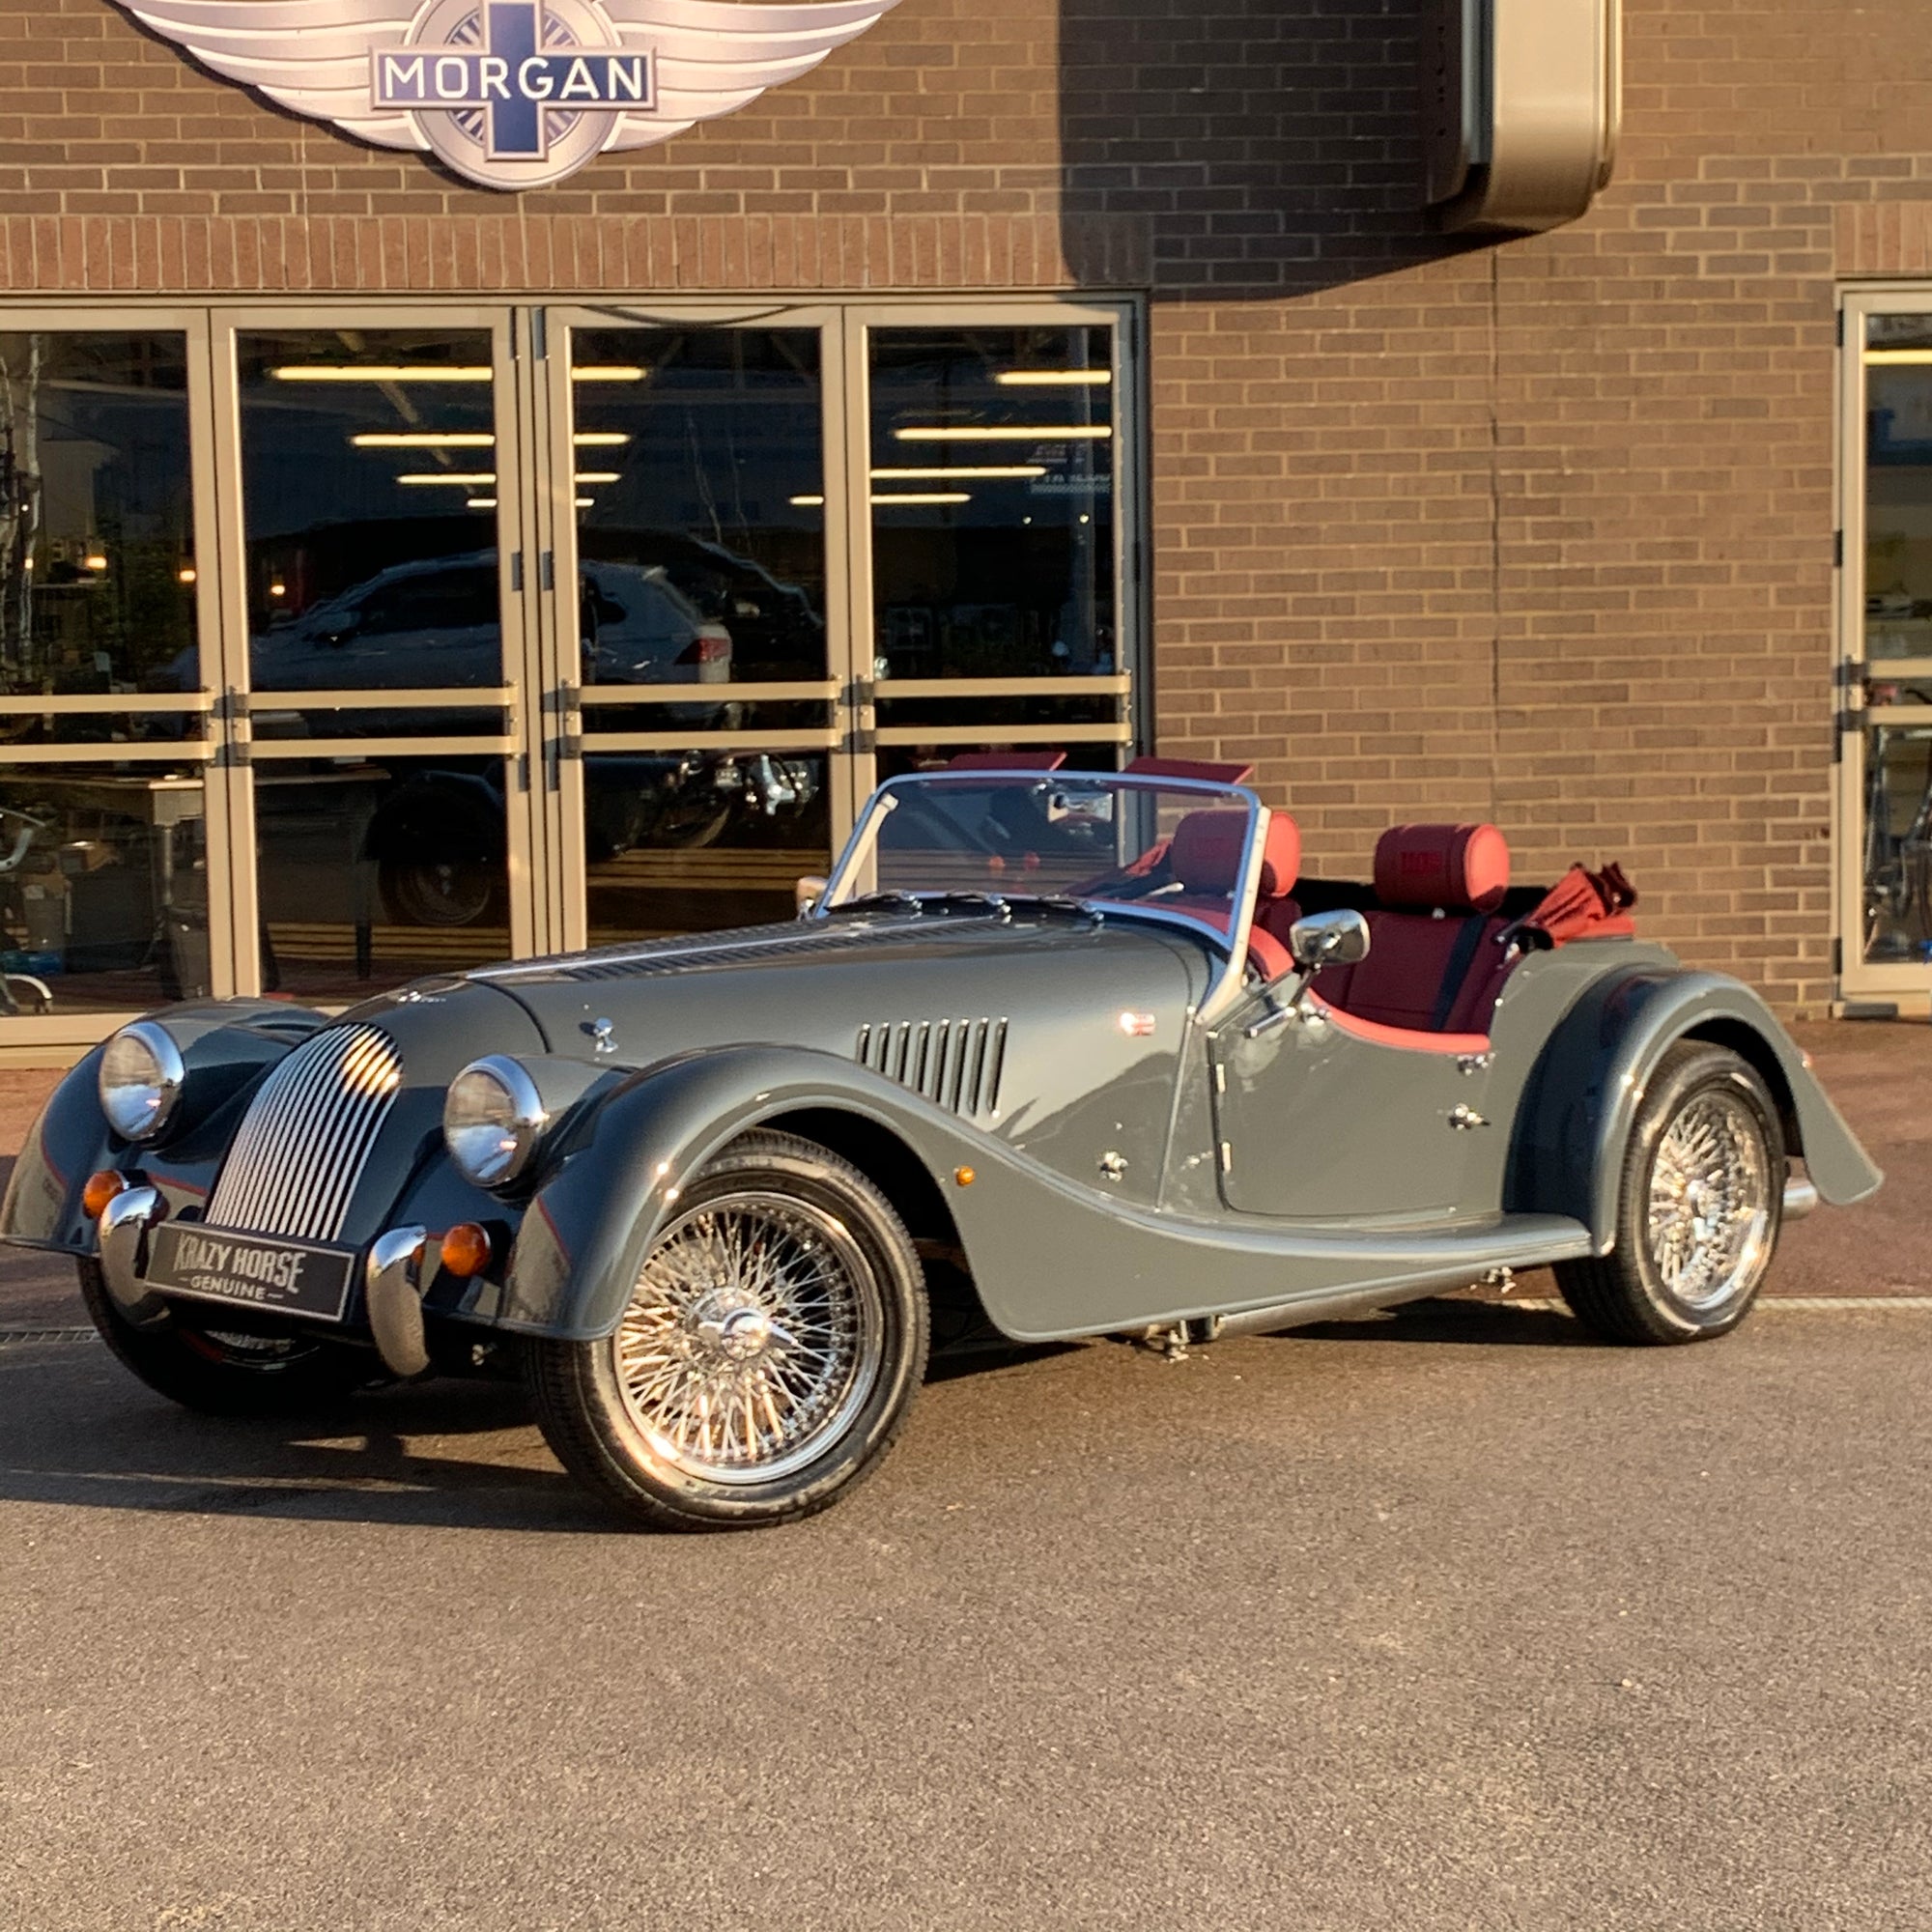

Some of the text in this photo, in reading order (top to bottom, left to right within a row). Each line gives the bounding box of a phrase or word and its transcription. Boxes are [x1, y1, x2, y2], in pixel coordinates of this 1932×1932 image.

[384, 56, 642, 100] MORGAN
[173, 1233, 306, 1294] KRAZY HORSE
[190, 1274, 266, 1300] GENUINE
